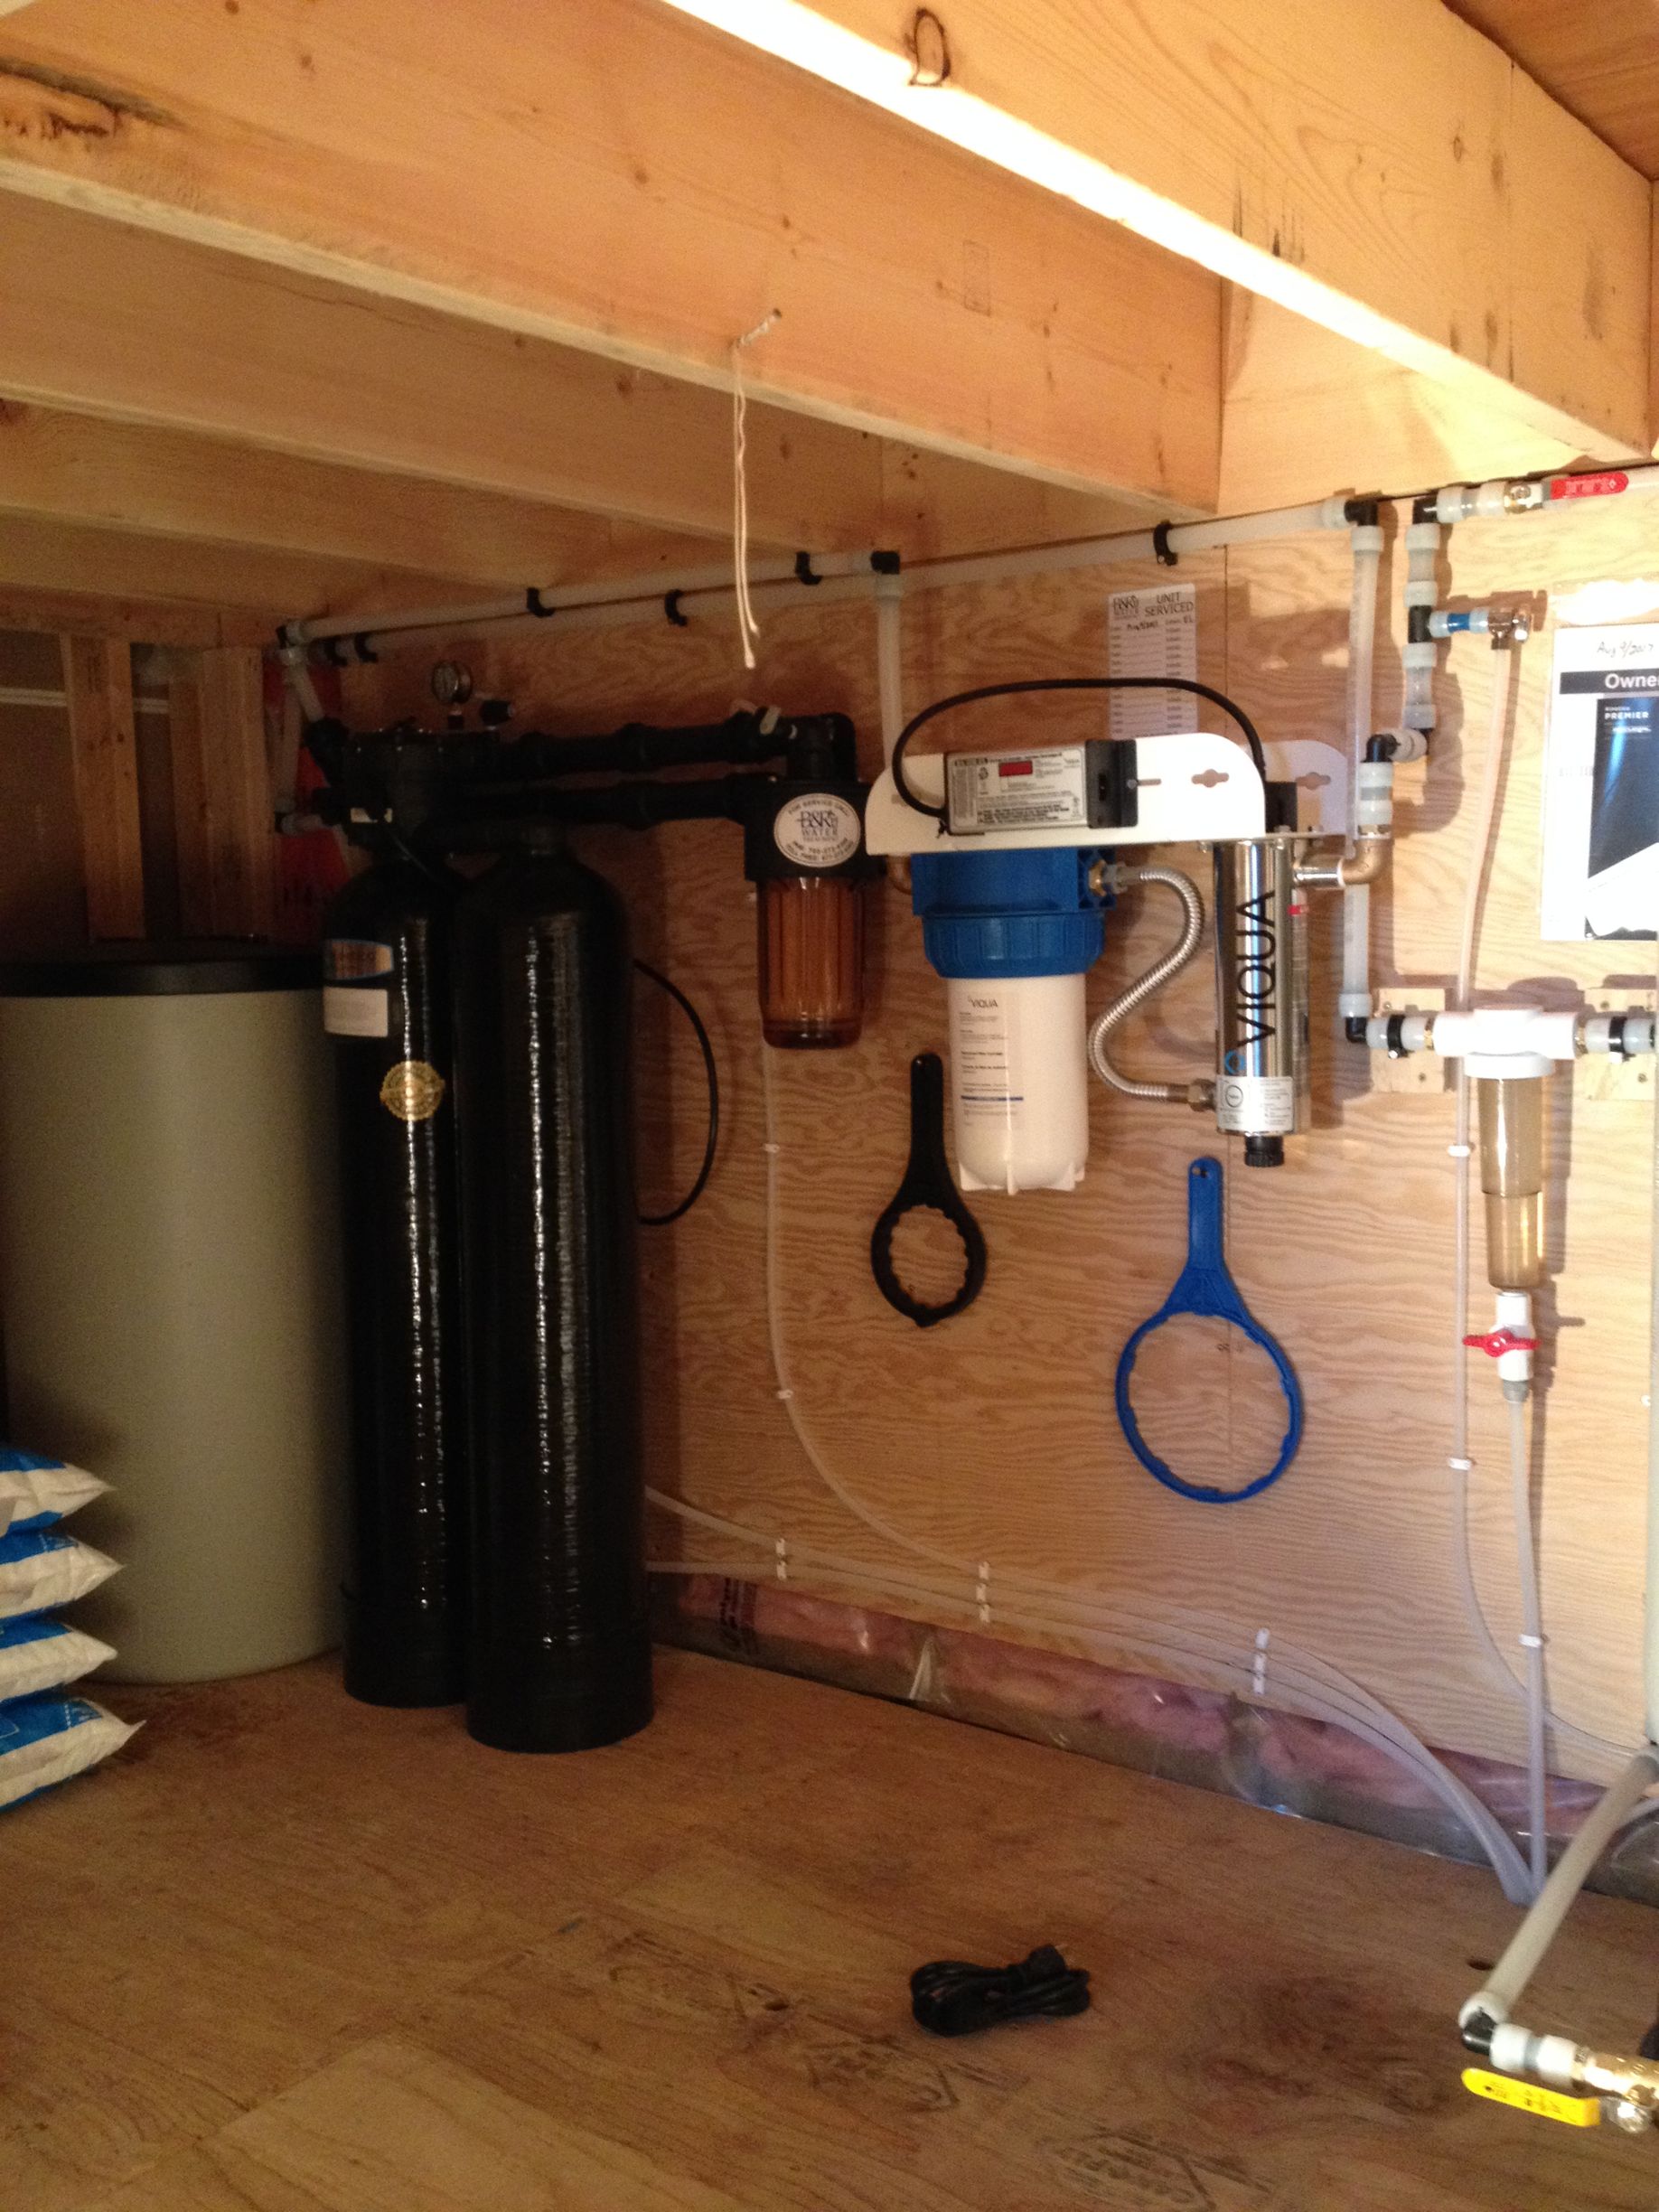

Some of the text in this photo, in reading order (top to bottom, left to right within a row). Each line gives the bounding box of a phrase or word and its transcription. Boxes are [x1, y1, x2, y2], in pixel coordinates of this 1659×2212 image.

[1156, 592, 1180, 605] UNIT
[1145, 602, 1194, 616] SERVICED
[1604, 711, 1649, 720] PREMIER
[1236, 890, 1276, 1049] VIQUA
